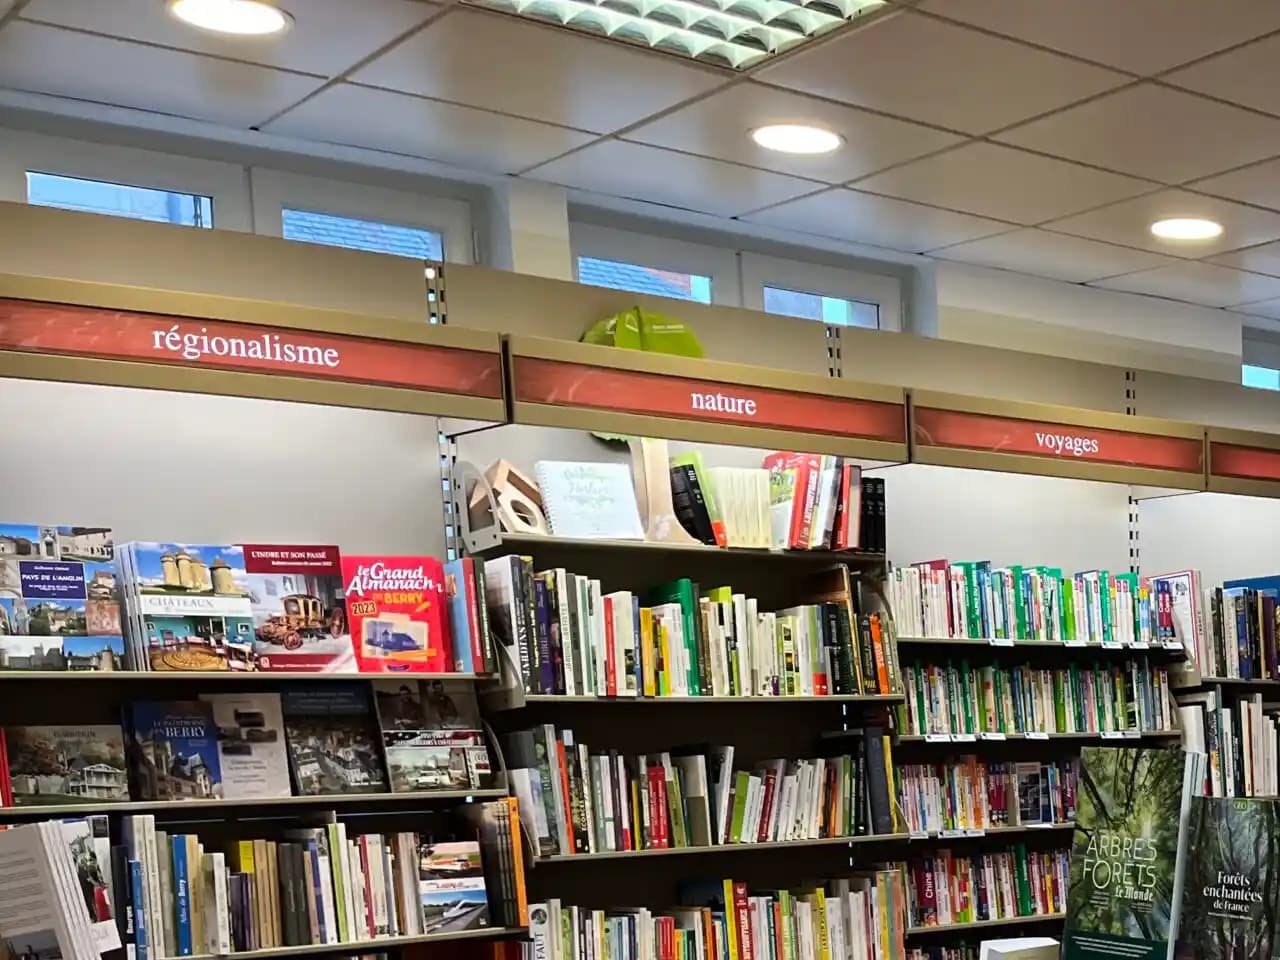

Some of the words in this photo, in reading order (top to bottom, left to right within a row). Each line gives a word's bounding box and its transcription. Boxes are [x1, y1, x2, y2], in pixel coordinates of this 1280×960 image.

[151, 324, 340, 367] régionalisme
[690, 389, 758, 416] nature
[1034, 431, 1100, 456] voyages
[371, 562, 424, 579] Grand
[346, 575, 434, 596] Almanach
[351, 601, 376, 616] 2023
[166, 725, 205, 737] BERRY
[1086, 835, 1158, 861] ARBRES
[924, 872, 934, 899] Chine
[1217, 871, 1251, 887] Forêts
[1124, 885, 1154, 902] Monde
[1202, 885, 1264, 903] enchantées
[1213, 902, 1224, 910] de
[1223, 902, 1251, 913] France
